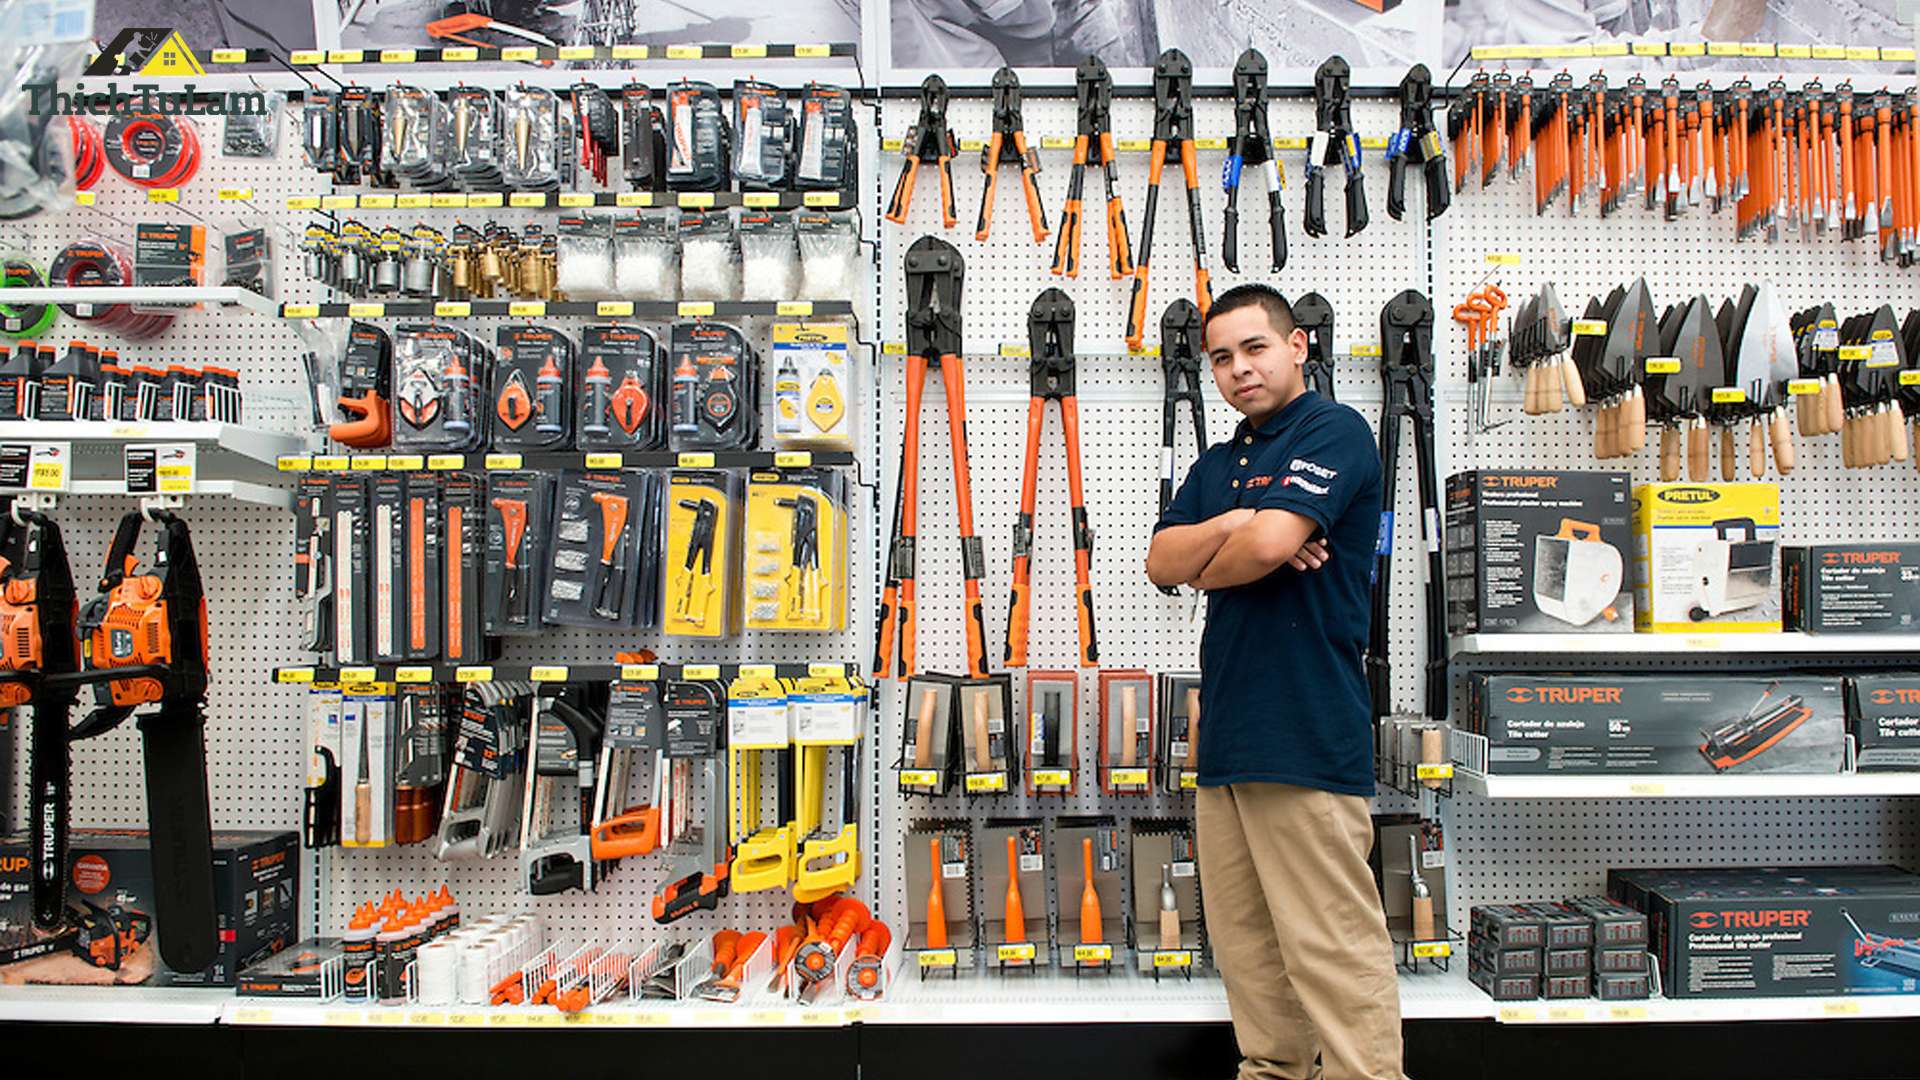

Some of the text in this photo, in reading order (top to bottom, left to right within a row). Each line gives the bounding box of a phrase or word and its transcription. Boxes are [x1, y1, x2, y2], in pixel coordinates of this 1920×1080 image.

[1501, 476, 1558, 488] TRUPER
[1662, 490, 1714, 501] PRETUL
[1841, 551, 1901, 564] TRUPER
[1535, 687, 1622, 704] TRUPER
[1895, 688, 1920, 705] TR
[1507, 719, 1585, 729] Cortador de azulejo
[1878, 717, 1920, 727] Cortador
[1507, 730, 1549, 738] Tile cutter
[1879, 728, 1920, 737] Tile cutte
[43, 803, 55, 861] TRUPER
[1720, 910, 1809, 928] TRUPER
[1689, 933, 1721, 942] Cortador
[1723, 933, 1733, 941] de
